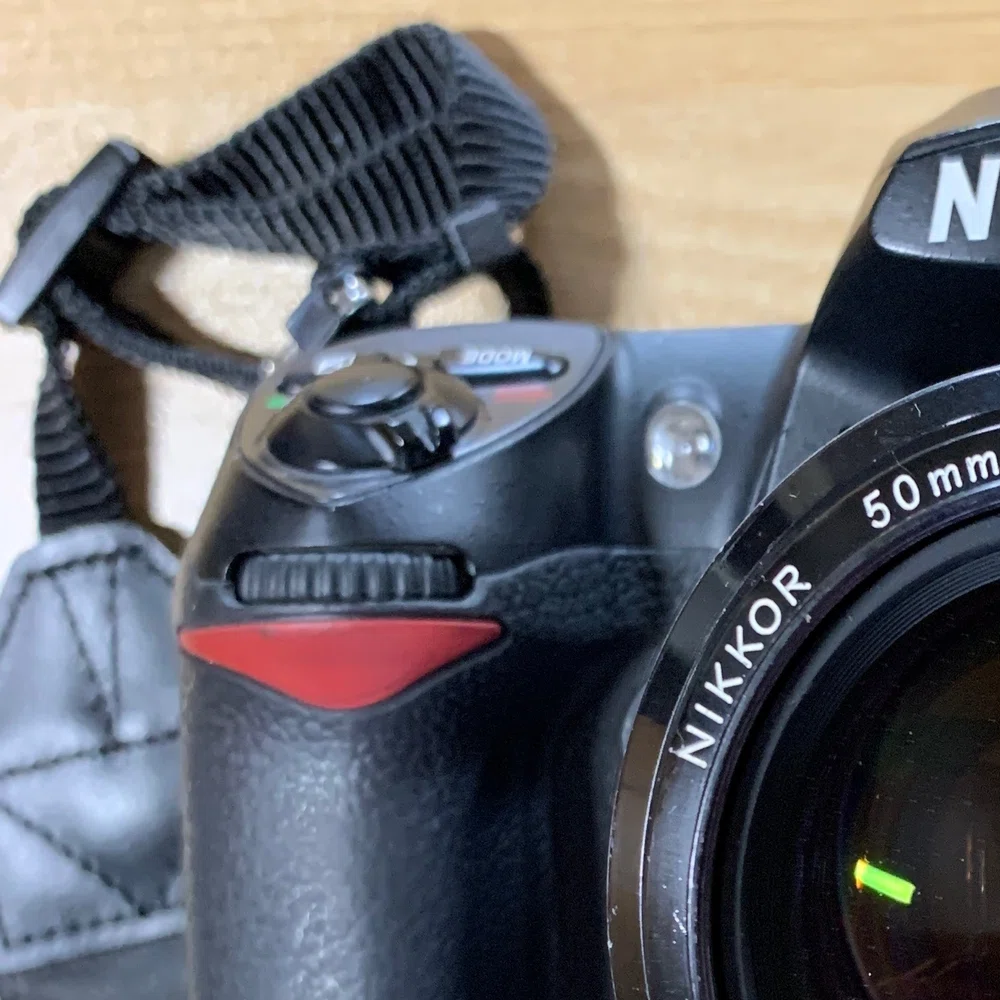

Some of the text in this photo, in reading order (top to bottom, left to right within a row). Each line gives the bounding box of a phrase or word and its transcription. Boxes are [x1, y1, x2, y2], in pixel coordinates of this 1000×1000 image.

[461, 345, 533, 364] MODE
[669, 563, 812, 768] NIKKOR
[862, 449, 1000, 529] 50mm
